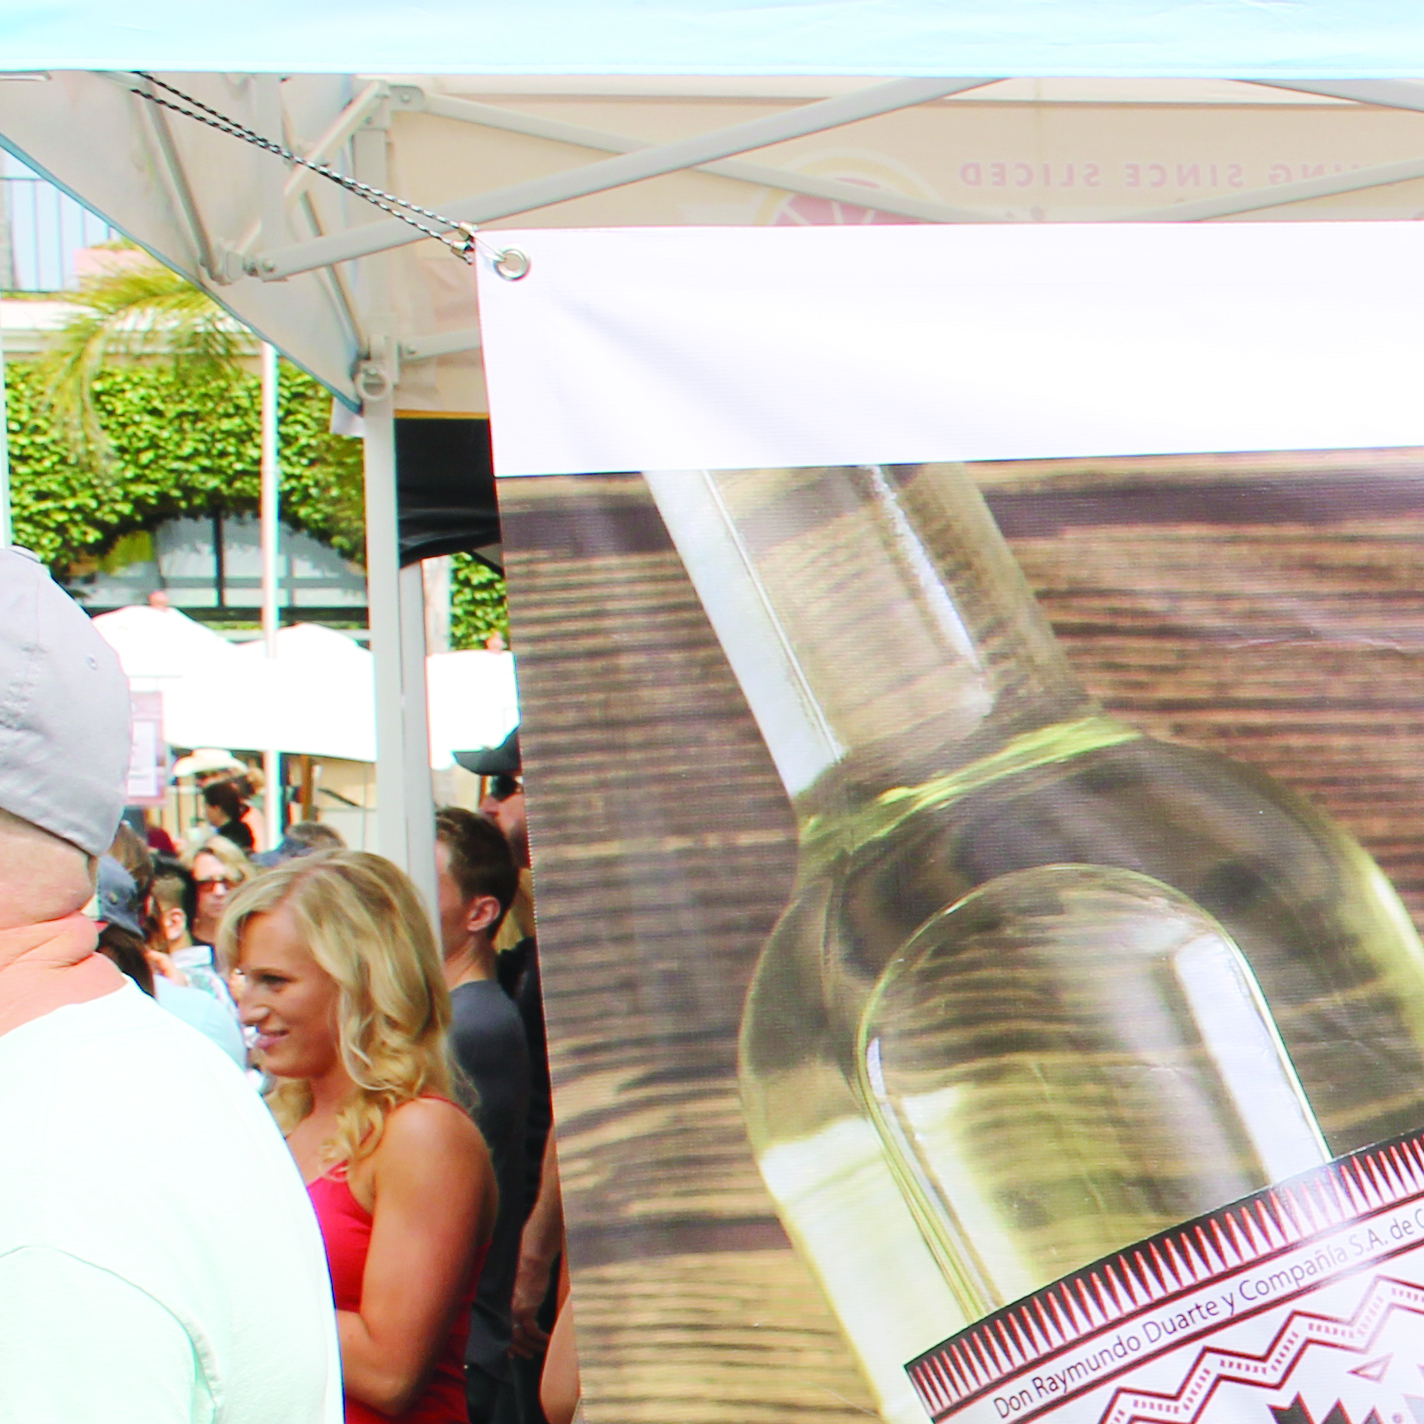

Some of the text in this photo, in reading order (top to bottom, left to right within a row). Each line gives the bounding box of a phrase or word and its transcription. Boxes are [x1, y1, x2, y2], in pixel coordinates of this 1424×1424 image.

[993, 1387, 1033, 1419] Don
[1032, 1334, 1141, 1394] Raymundo
[1142, 1300, 1220, 1344] Duarte
[1221, 1293, 1236, 1318] y
[1239, 1245, 1350, 1301] Compañía
[1389, 1217, 1415, 1240] de
